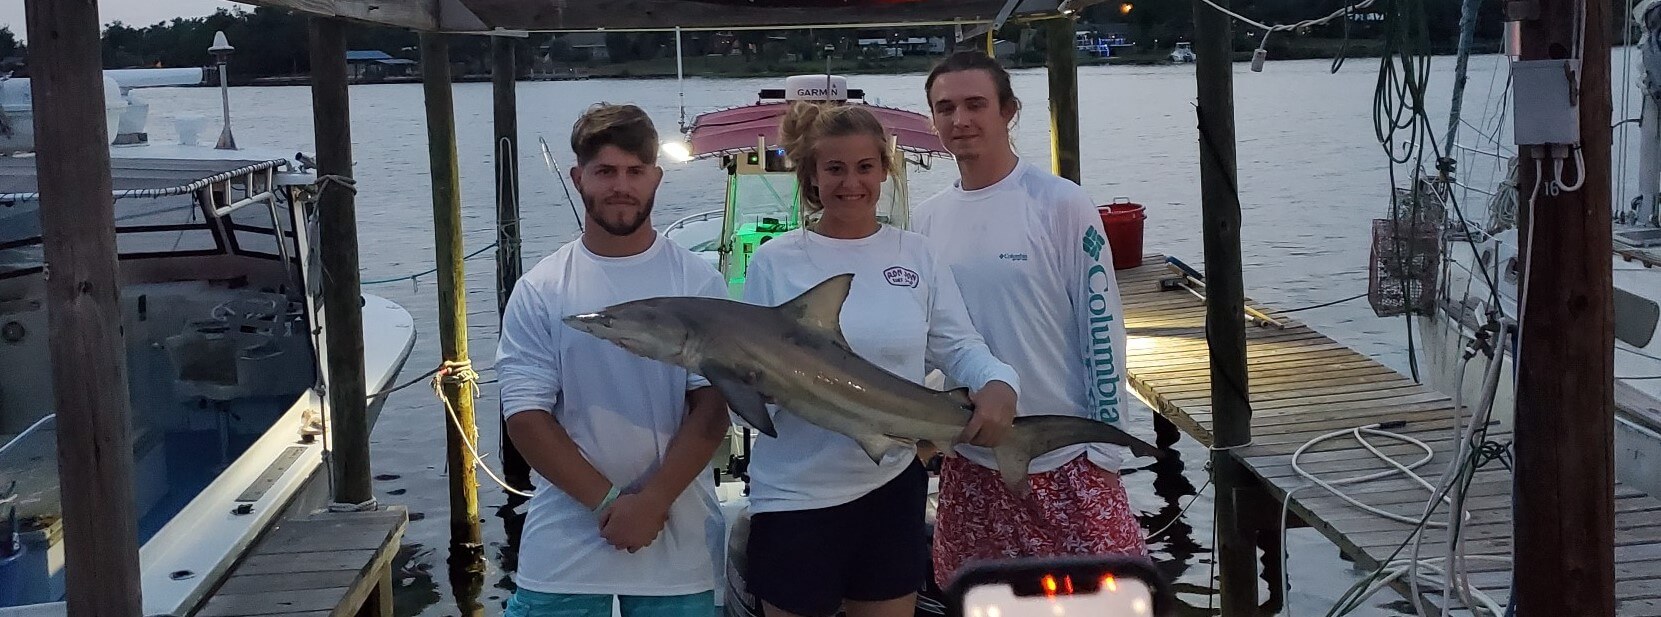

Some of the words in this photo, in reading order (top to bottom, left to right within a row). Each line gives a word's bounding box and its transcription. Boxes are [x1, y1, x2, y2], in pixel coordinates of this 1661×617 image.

[797, 88, 838, 97] GARMN
[1544, 180, 1560, 196] 16
[887, 269, 903, 279] RON
[1088, 264, 1121, 423] Columbia
